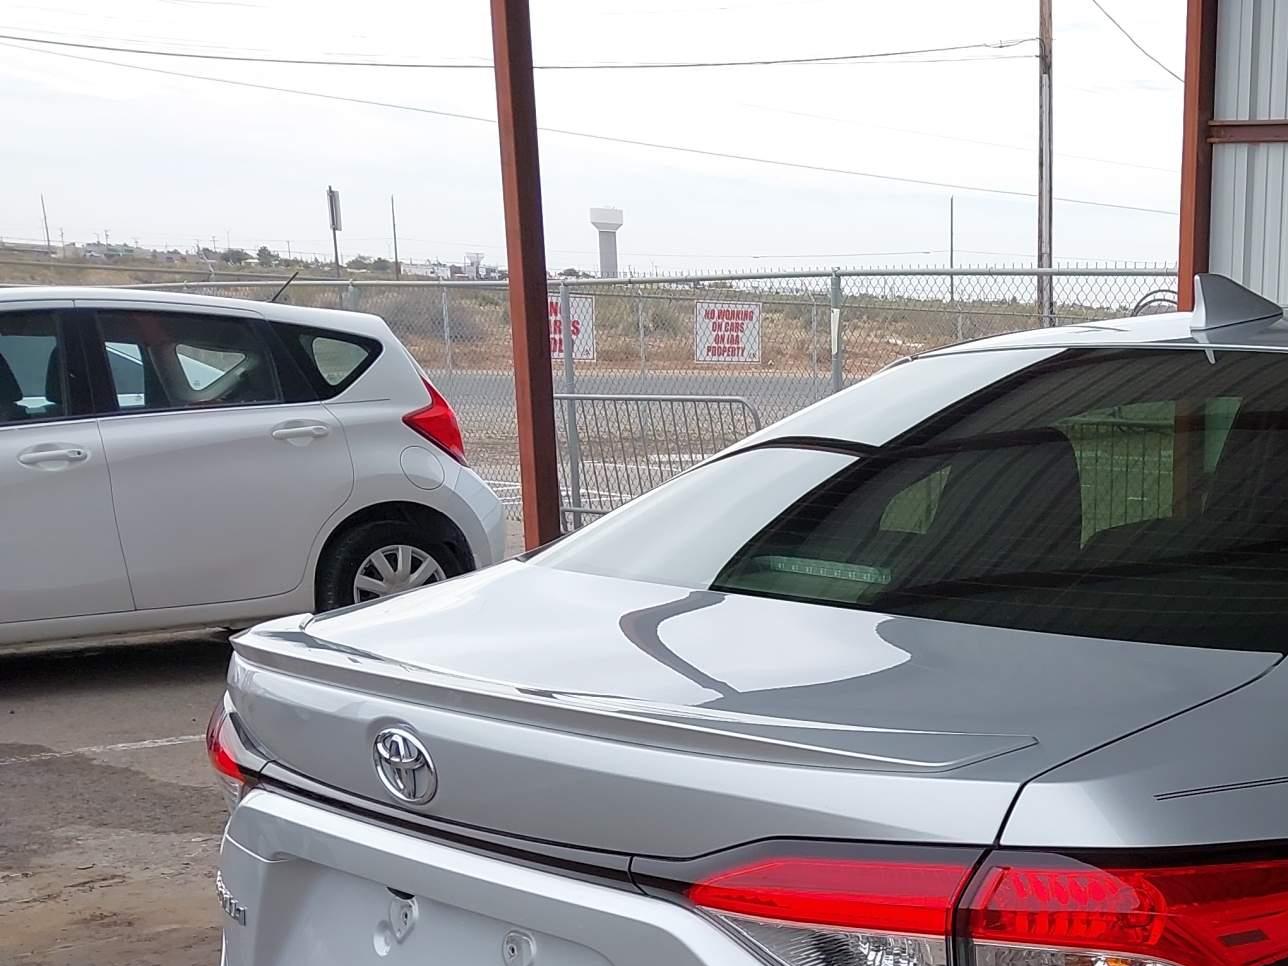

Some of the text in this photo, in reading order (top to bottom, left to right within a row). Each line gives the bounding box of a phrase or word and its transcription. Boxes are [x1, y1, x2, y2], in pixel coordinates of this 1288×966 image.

[704, 309, 754, 321] NO WORKING
[711, 321, 745, 334] ON CARS
[714, 334, 726, 345] ON
[706, 345, 746, 357] PROPERTY
